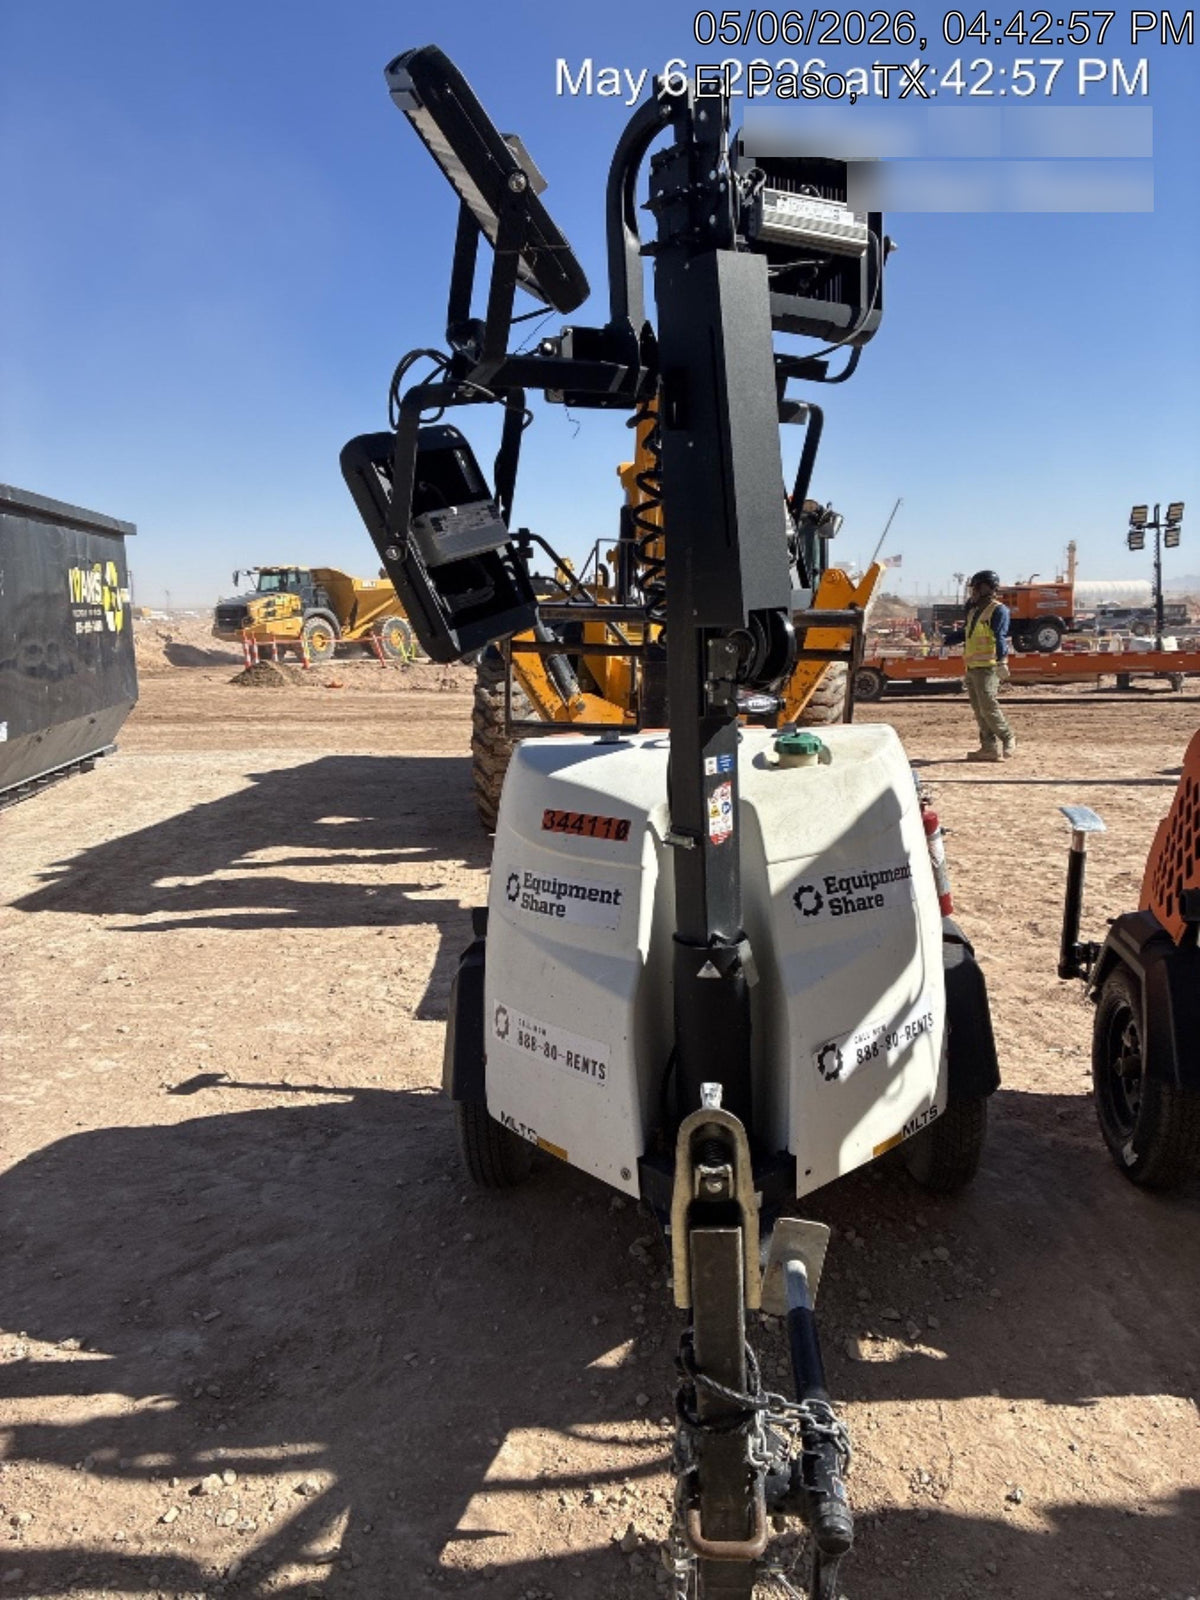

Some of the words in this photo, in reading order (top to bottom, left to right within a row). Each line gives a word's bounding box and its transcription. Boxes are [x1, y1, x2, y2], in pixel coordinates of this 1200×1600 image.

[523, 873, 622, 906] Equipment
[823, 862, 912, 895] Equipment
[520, 892, 566, 917] Share
[828, 893, 885, 917] Share
[856, 1012, 935, 1065] 888-80-RENTS
[902, 1104, 939, 1138] MLTS
